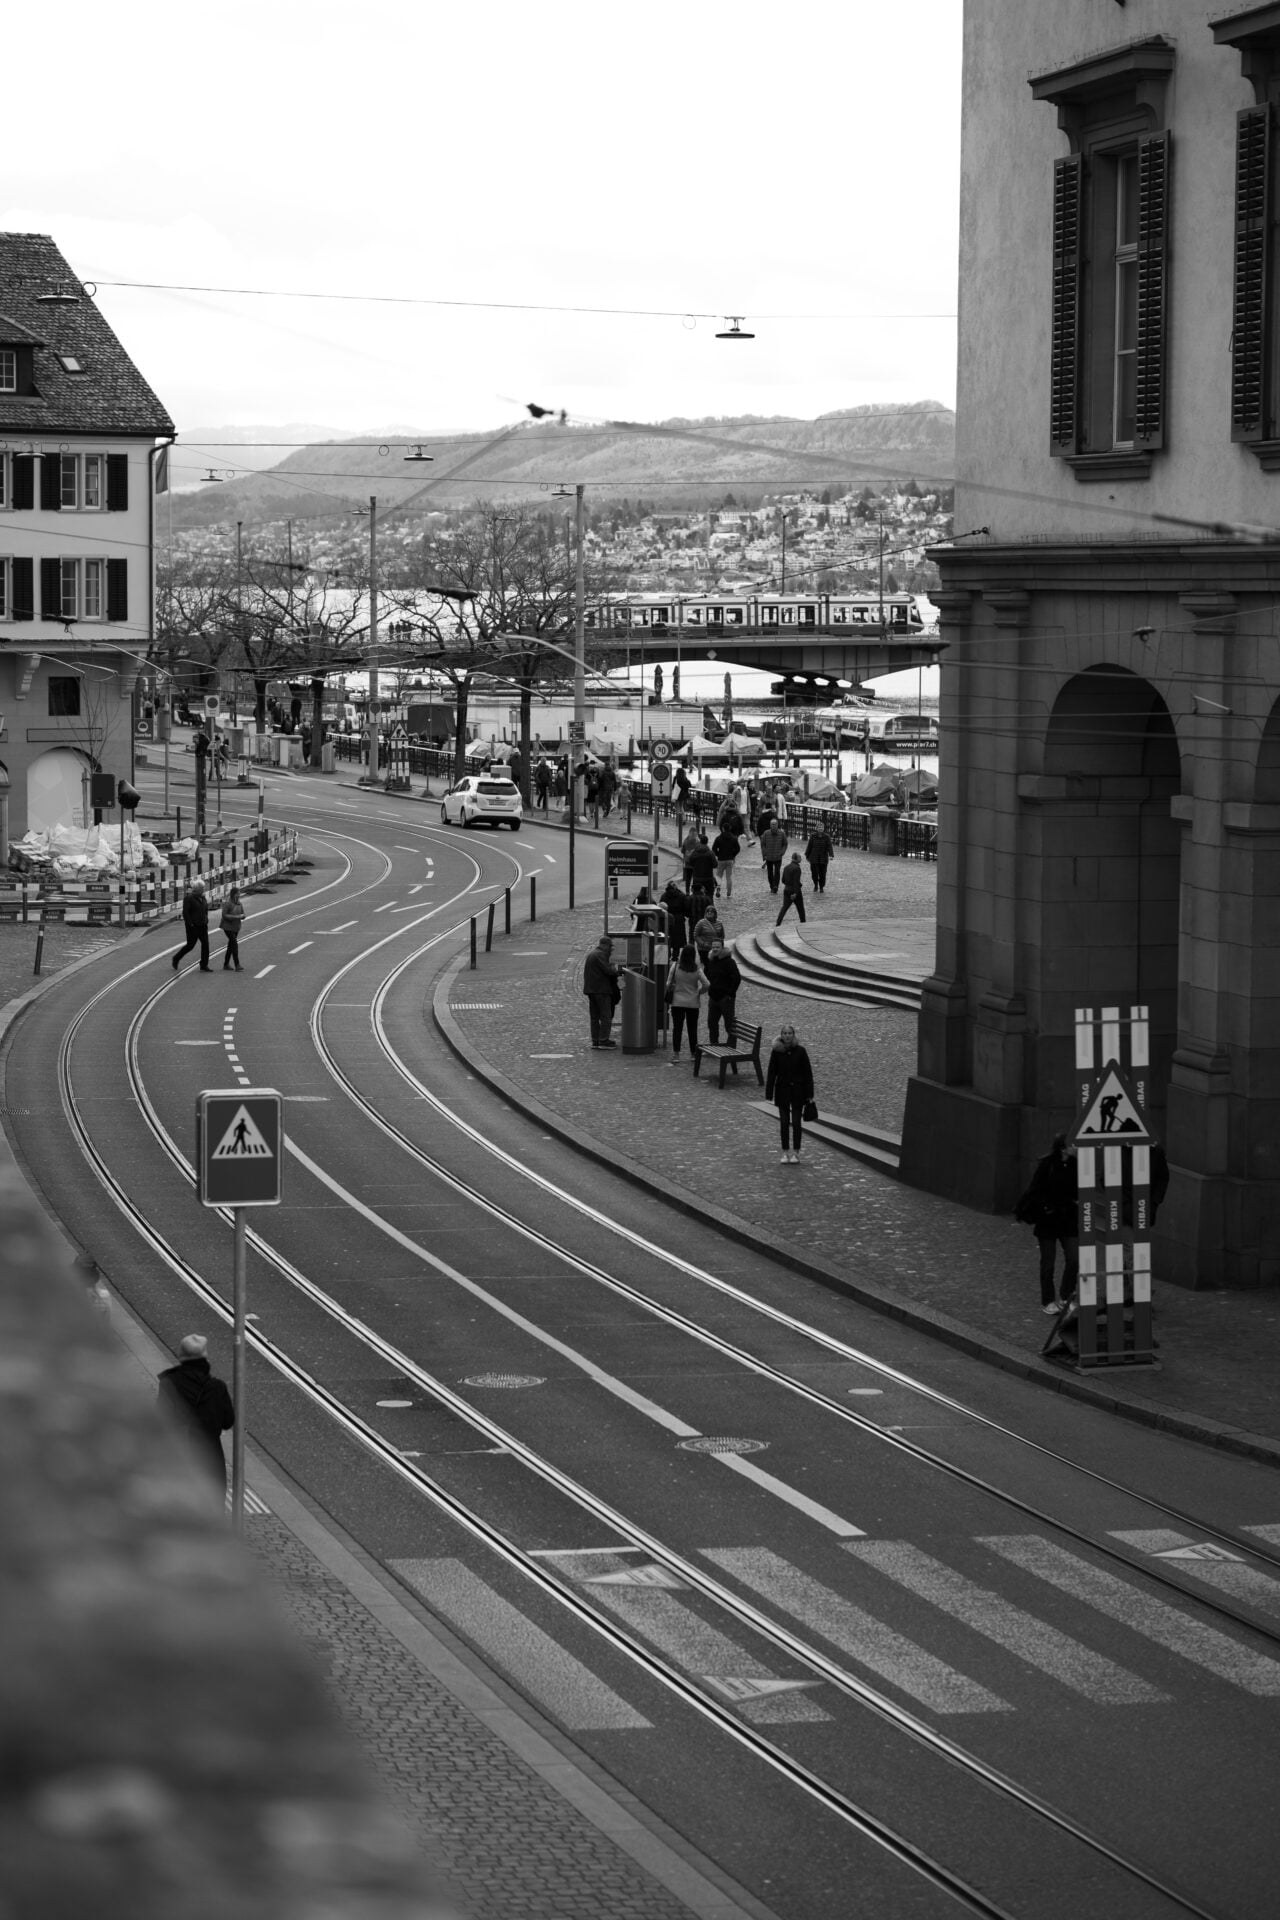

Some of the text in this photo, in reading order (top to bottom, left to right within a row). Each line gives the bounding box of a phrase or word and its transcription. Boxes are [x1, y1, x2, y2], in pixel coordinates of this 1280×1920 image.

[1081, 1083, 1090, 1107] BAG
[1083, 1202, 1092, 1232] KIBAG
[1110, 1201, 1118, 1231] KIBAG
[1138, 1199, 1146, 1229] KIBAG
